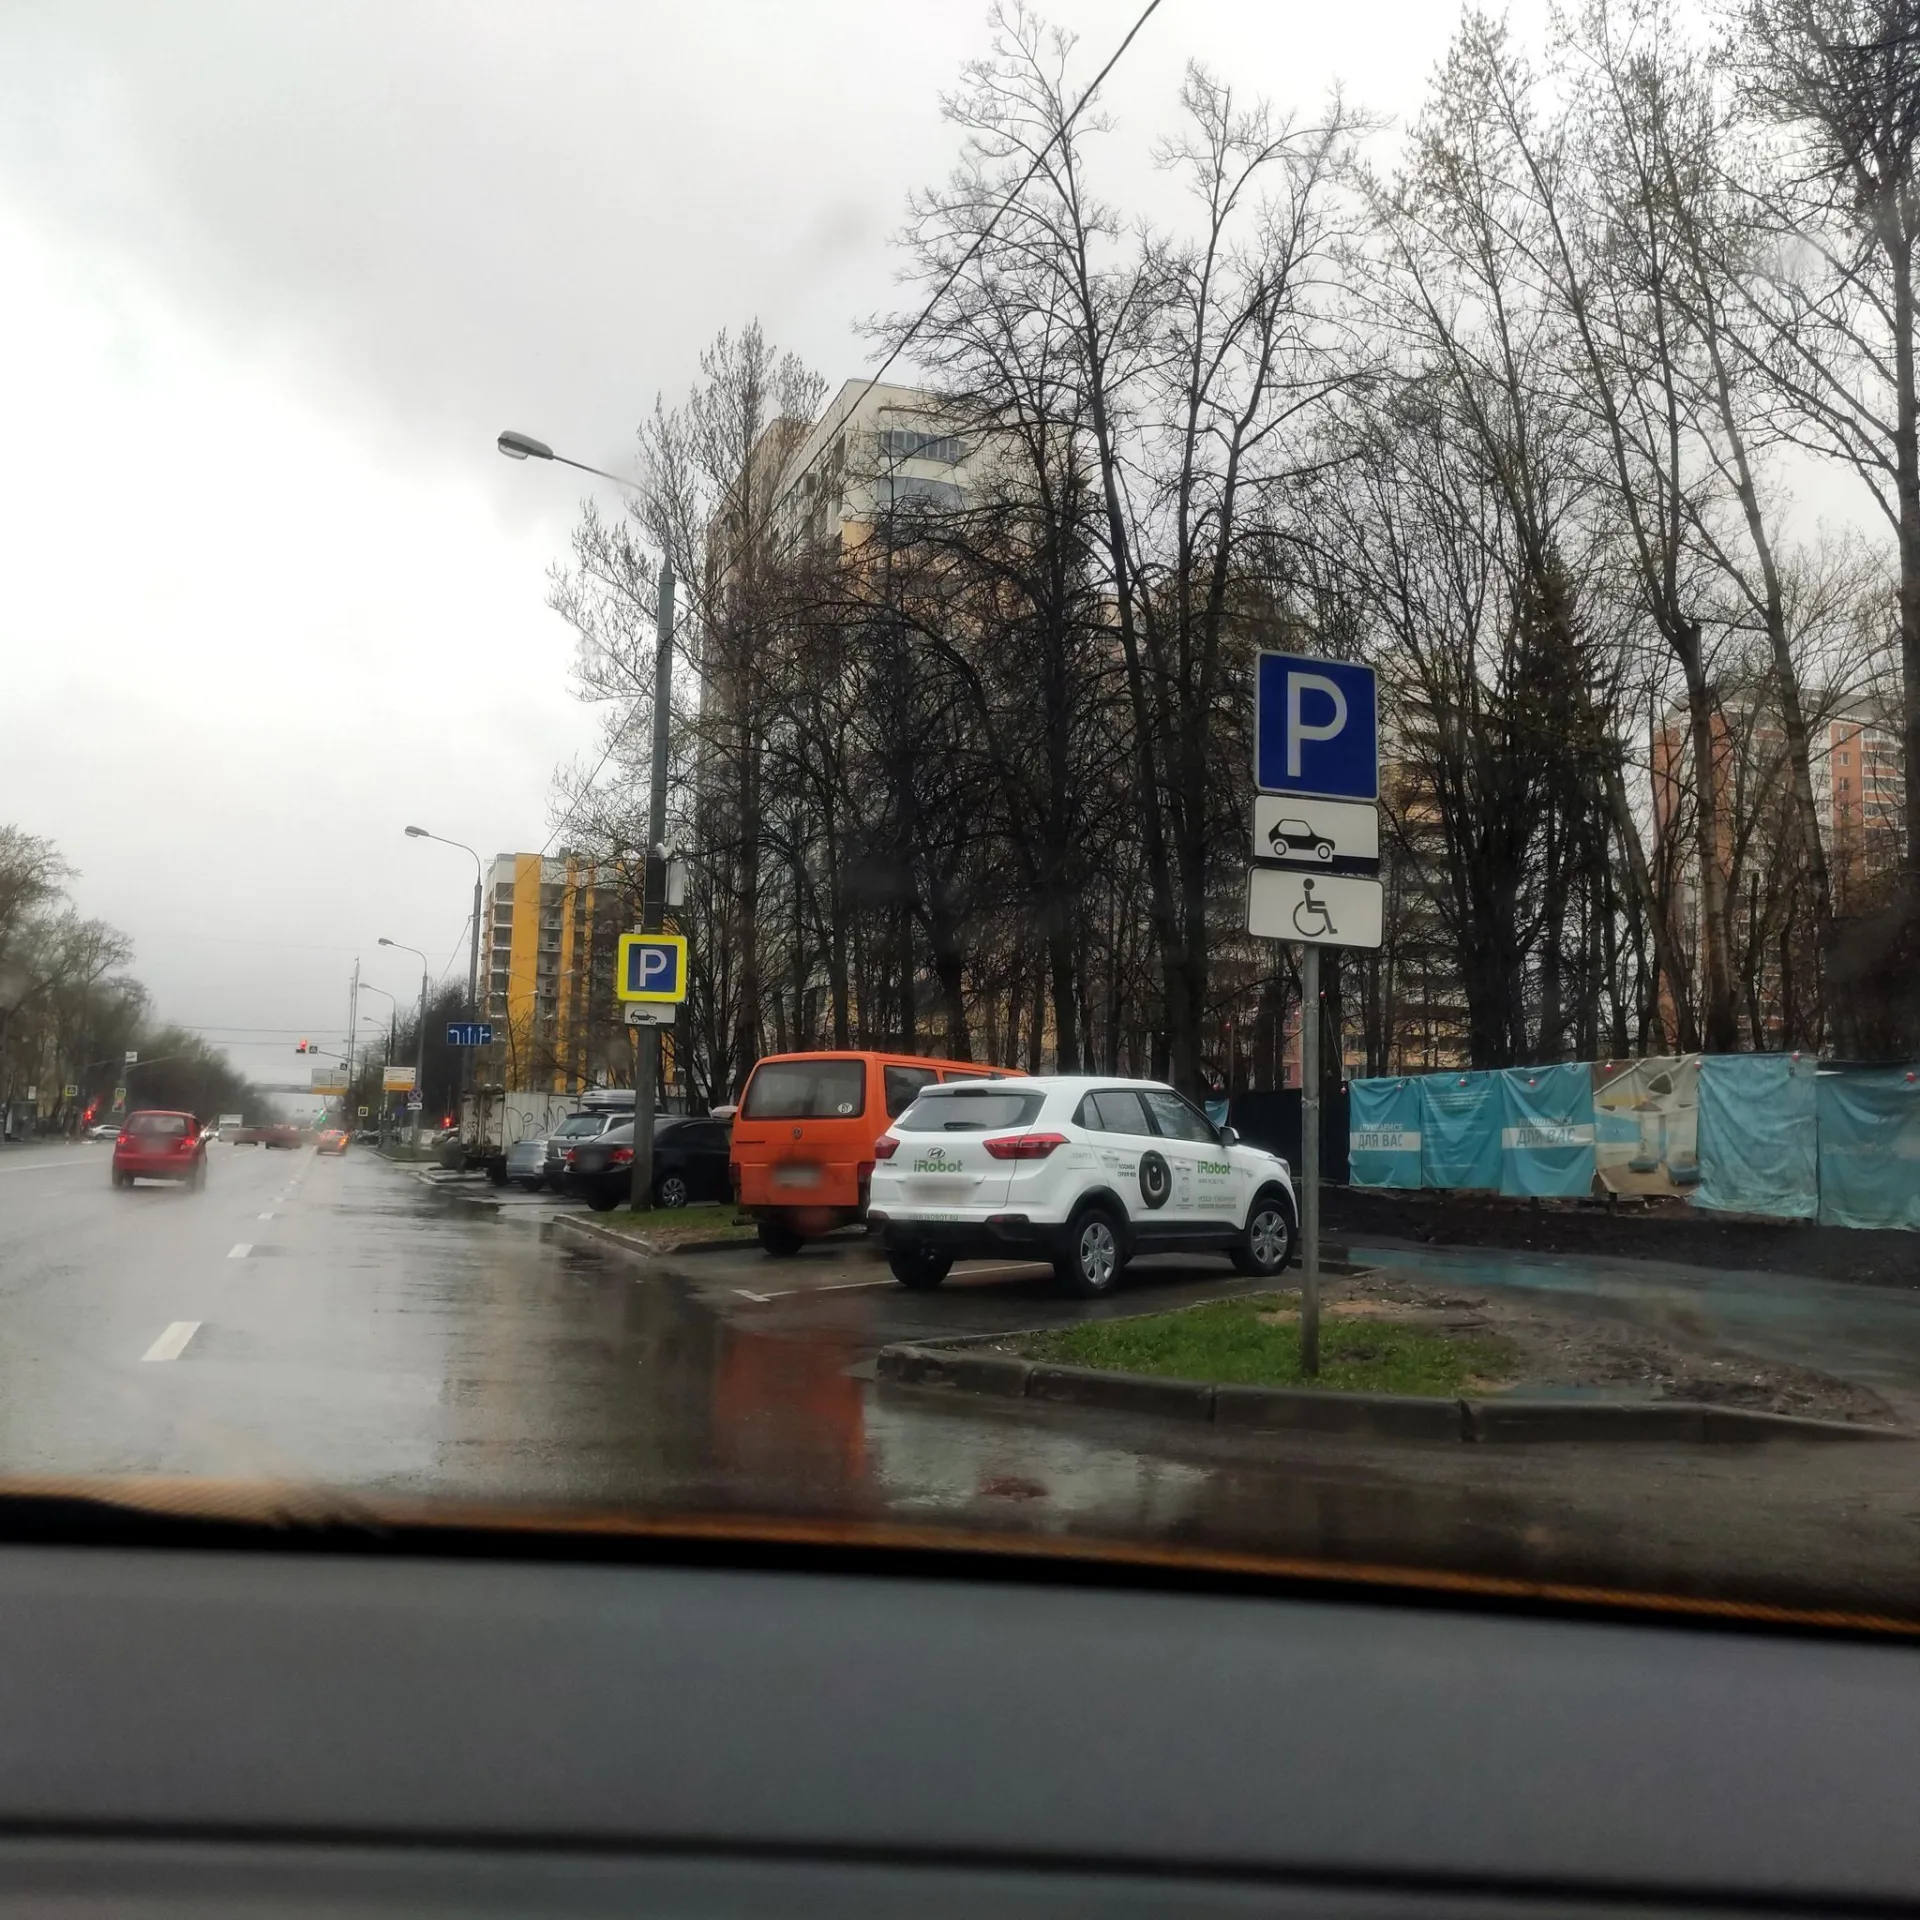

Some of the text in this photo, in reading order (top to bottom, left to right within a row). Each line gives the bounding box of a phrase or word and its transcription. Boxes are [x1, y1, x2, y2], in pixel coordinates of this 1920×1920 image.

[1287, 671, 1348, 777] P
[639, 949, 667, 987] P
[1358, 1134, 1402, 1150] ДЛЯ ВАС
[913, 1159, 963, 1173] iRobot
[1197, 1160, 1231, 1175] iRobot
